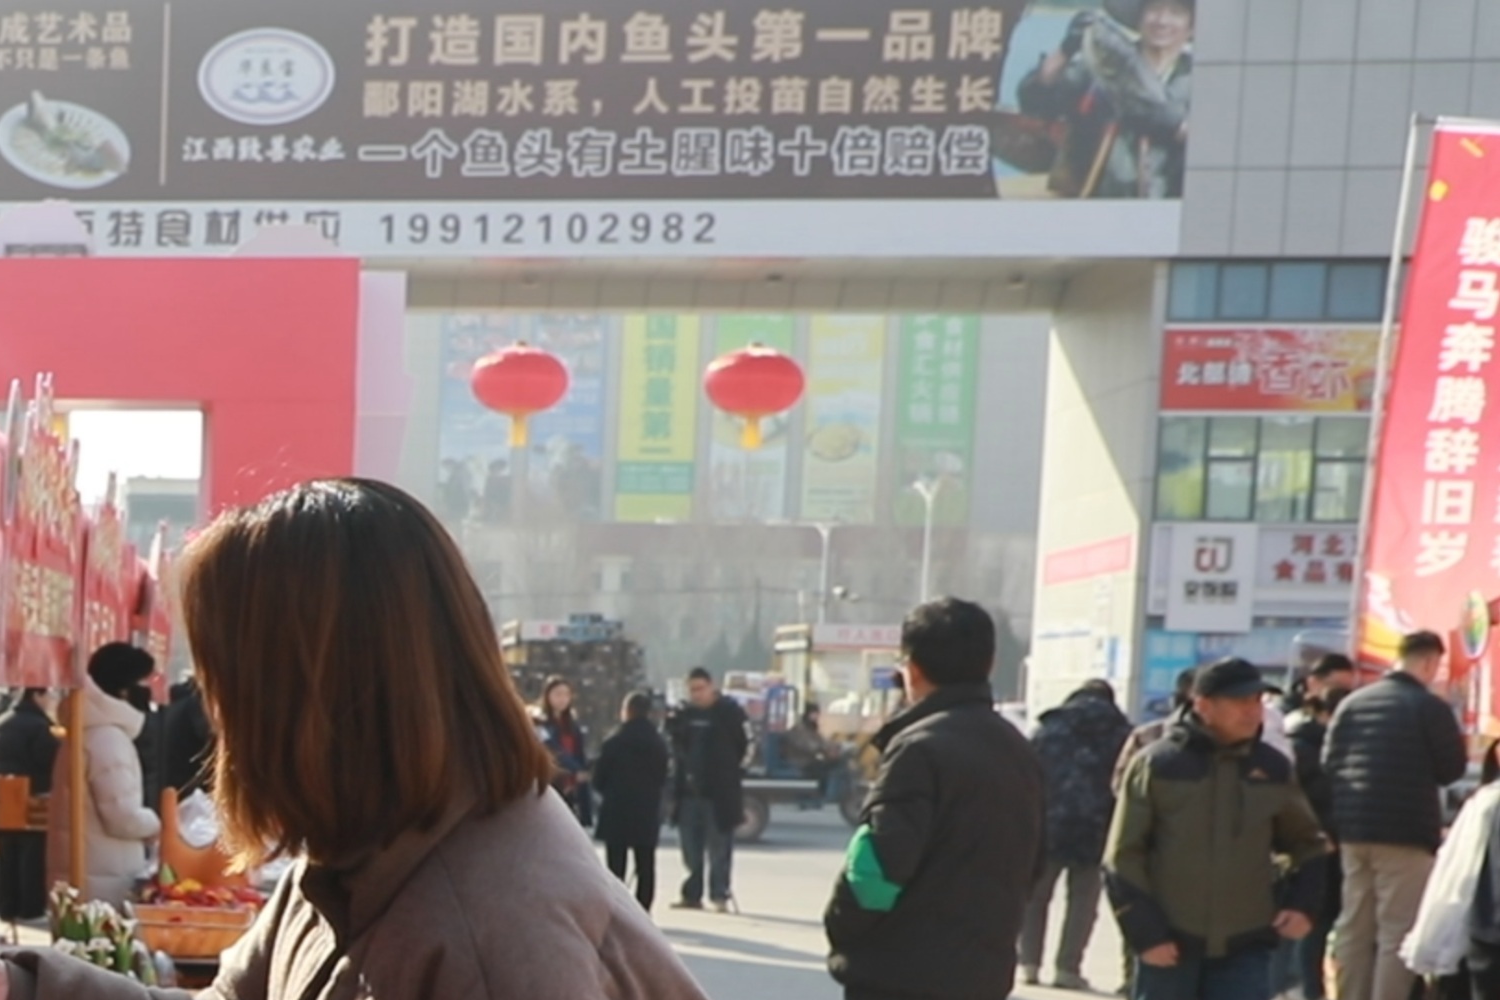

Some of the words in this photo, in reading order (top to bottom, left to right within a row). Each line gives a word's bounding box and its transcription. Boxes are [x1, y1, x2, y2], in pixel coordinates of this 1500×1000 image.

[365, 7, 1002, 67] 打造国内鱼头第一品牌
[358, 125, 991, 177] 一个鱼头有土腥味十倍赔偿
[380, 212, 717, 244] 19912102982
[1414, 216, 1500, 578] 骏马奔腾辞旧岁
[1291, 534, 1359, 556] 河北
